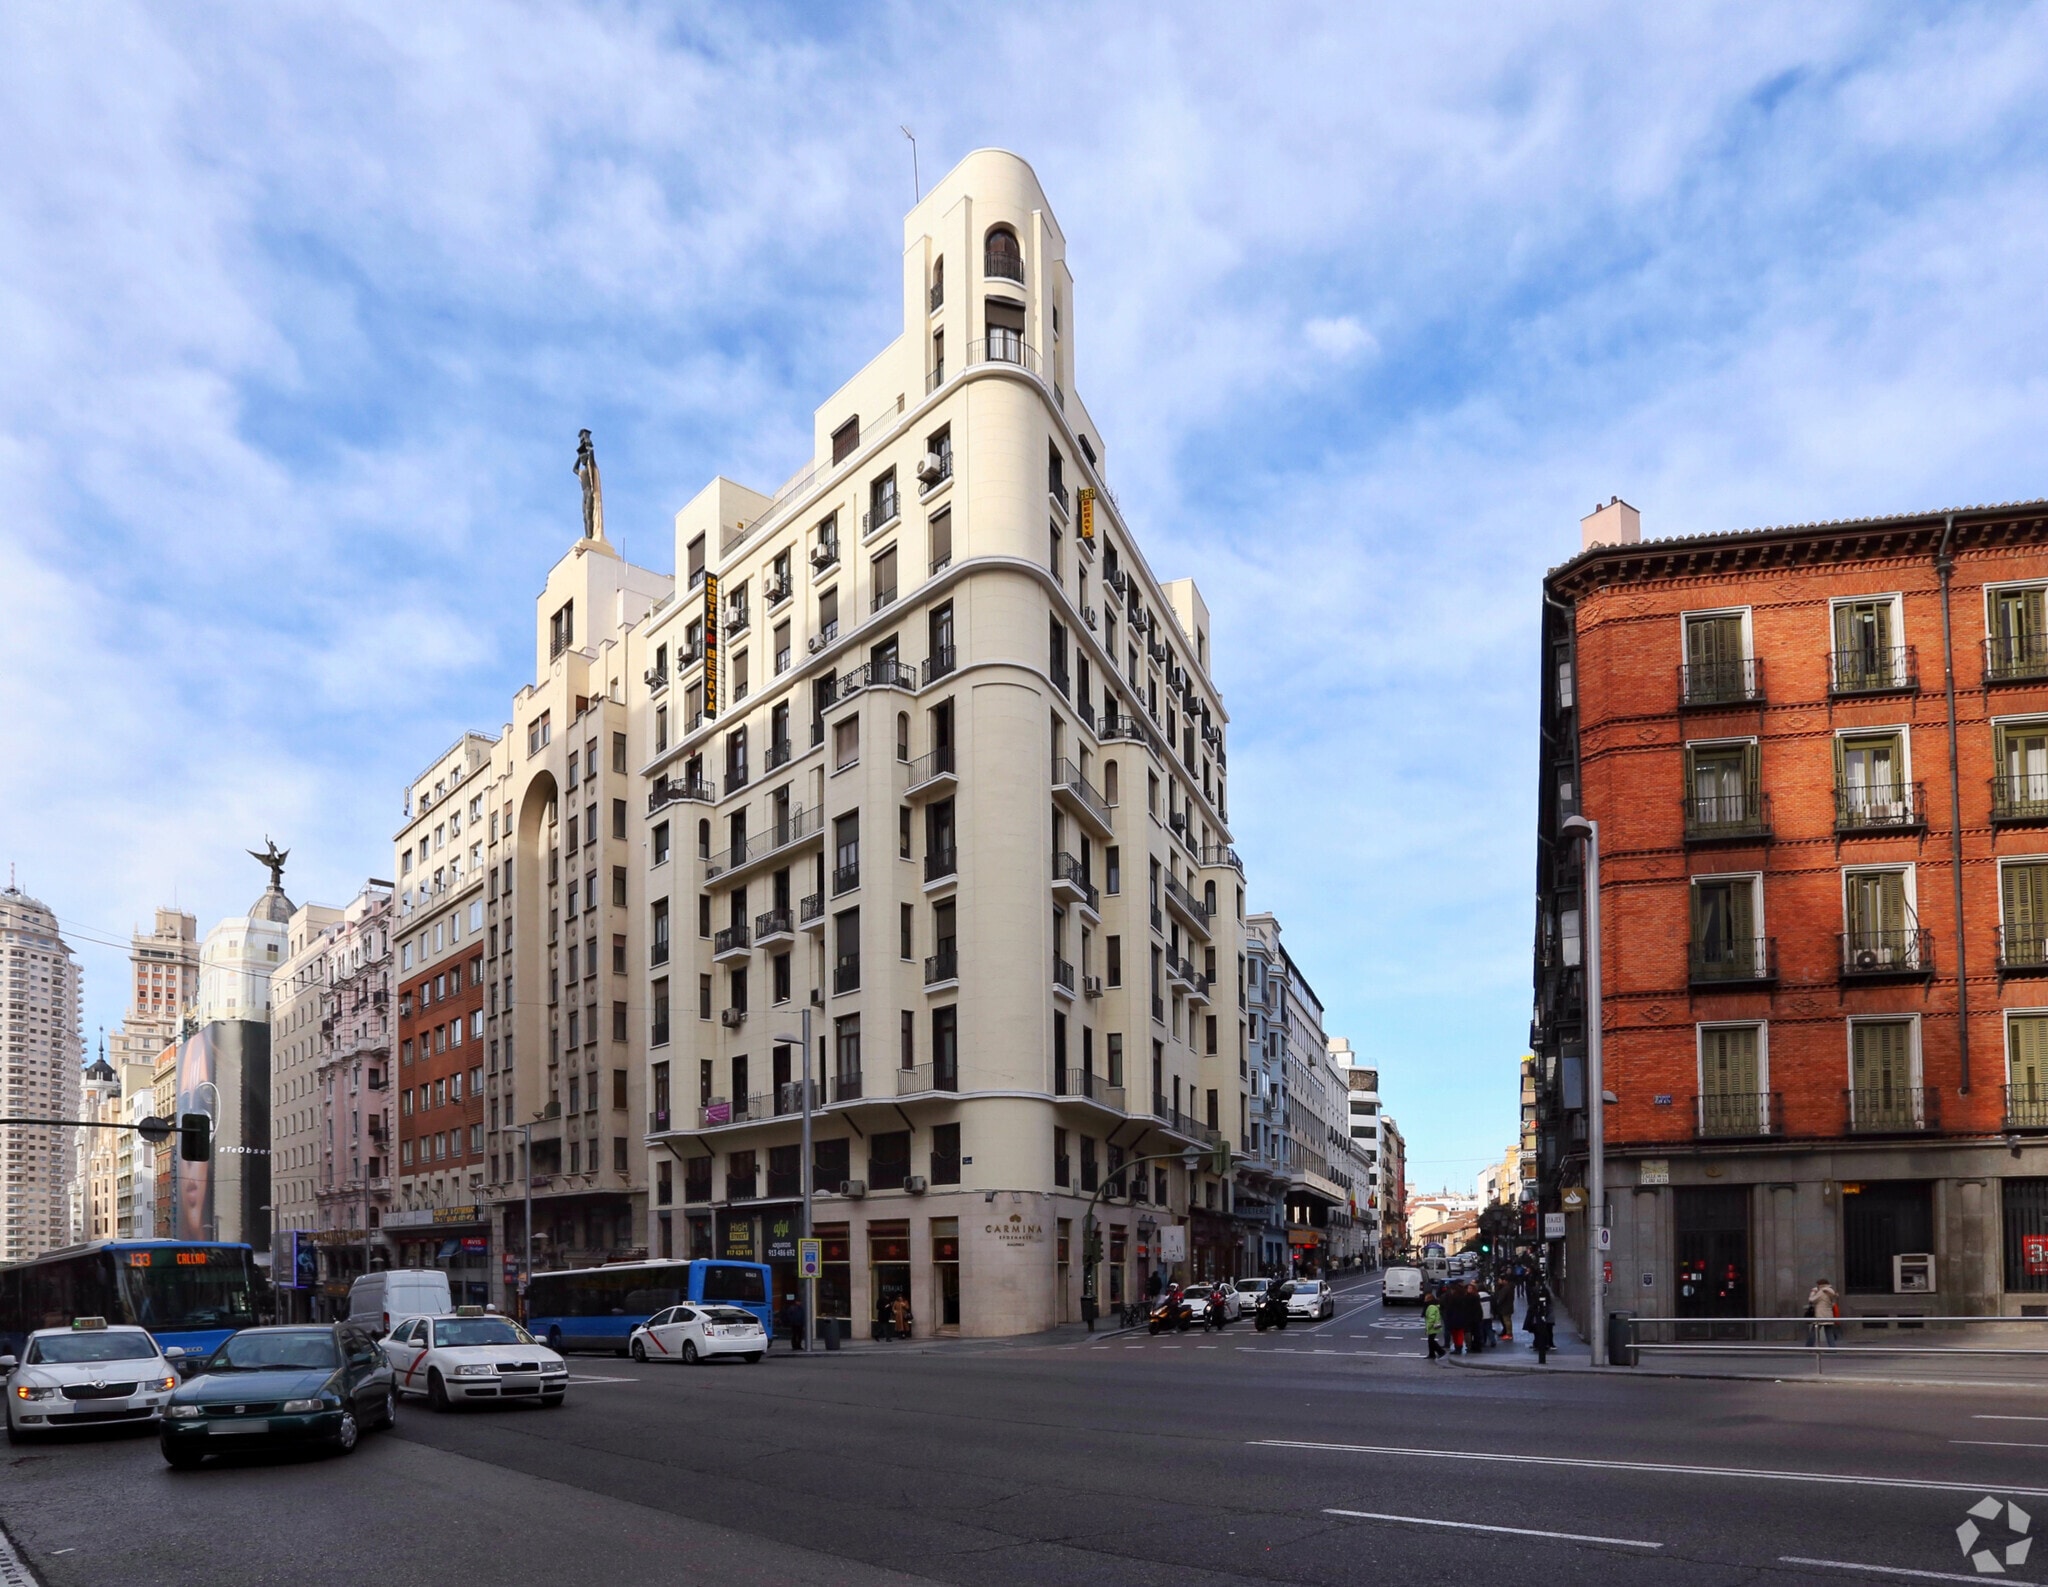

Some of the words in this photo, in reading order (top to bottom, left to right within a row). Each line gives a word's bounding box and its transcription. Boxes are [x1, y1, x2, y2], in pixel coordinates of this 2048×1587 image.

[707, 577, 717, 629] HOSTAL
[707, 649, 716, 711] BESAYA
[985, 1225, 1042, 1233] CARMINA
[130, 1253, 151, 1267] 133
[176, 1253, 207, 1265] CALLAO
